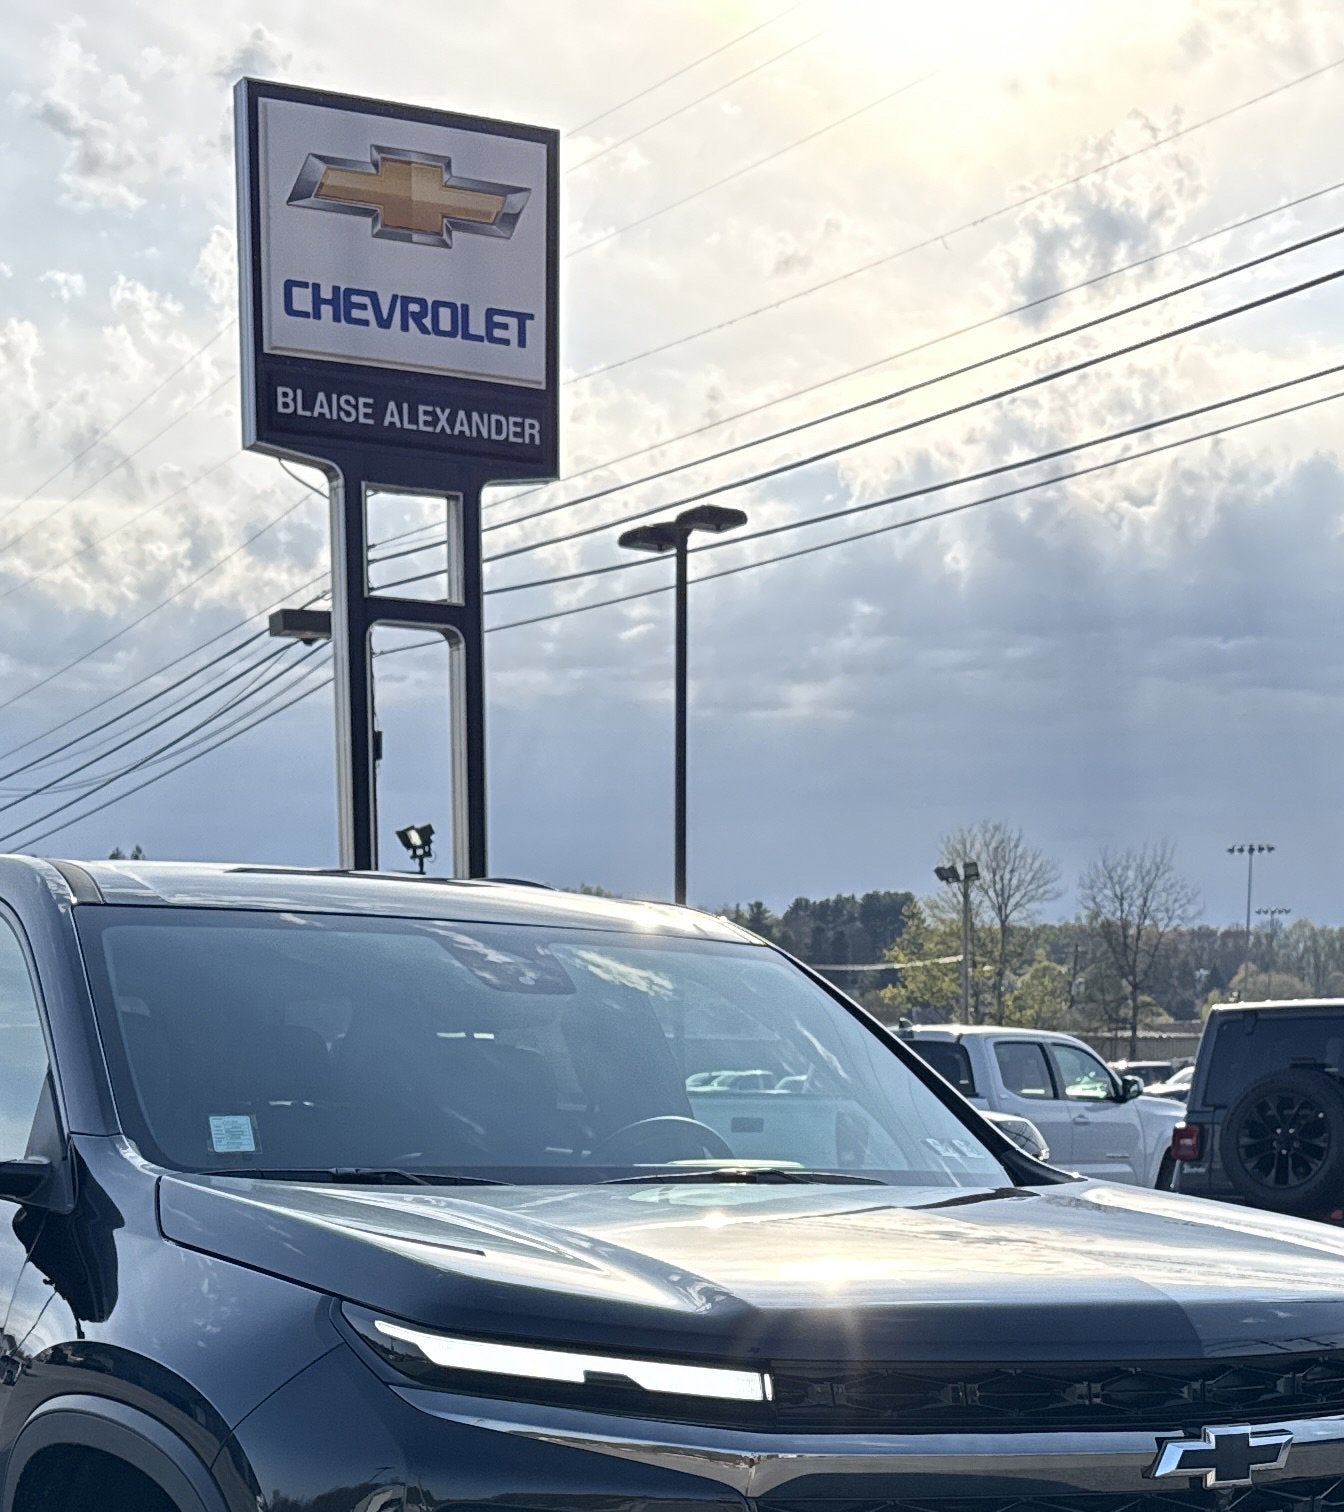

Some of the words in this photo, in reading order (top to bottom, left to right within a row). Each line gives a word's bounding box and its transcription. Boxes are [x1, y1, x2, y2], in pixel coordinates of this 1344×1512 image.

[282, 278, 535, 349] CHEVROLET
[275, 385, 375, 425] BLAISE
[382, 400, 542, 446] ALEXANDER
